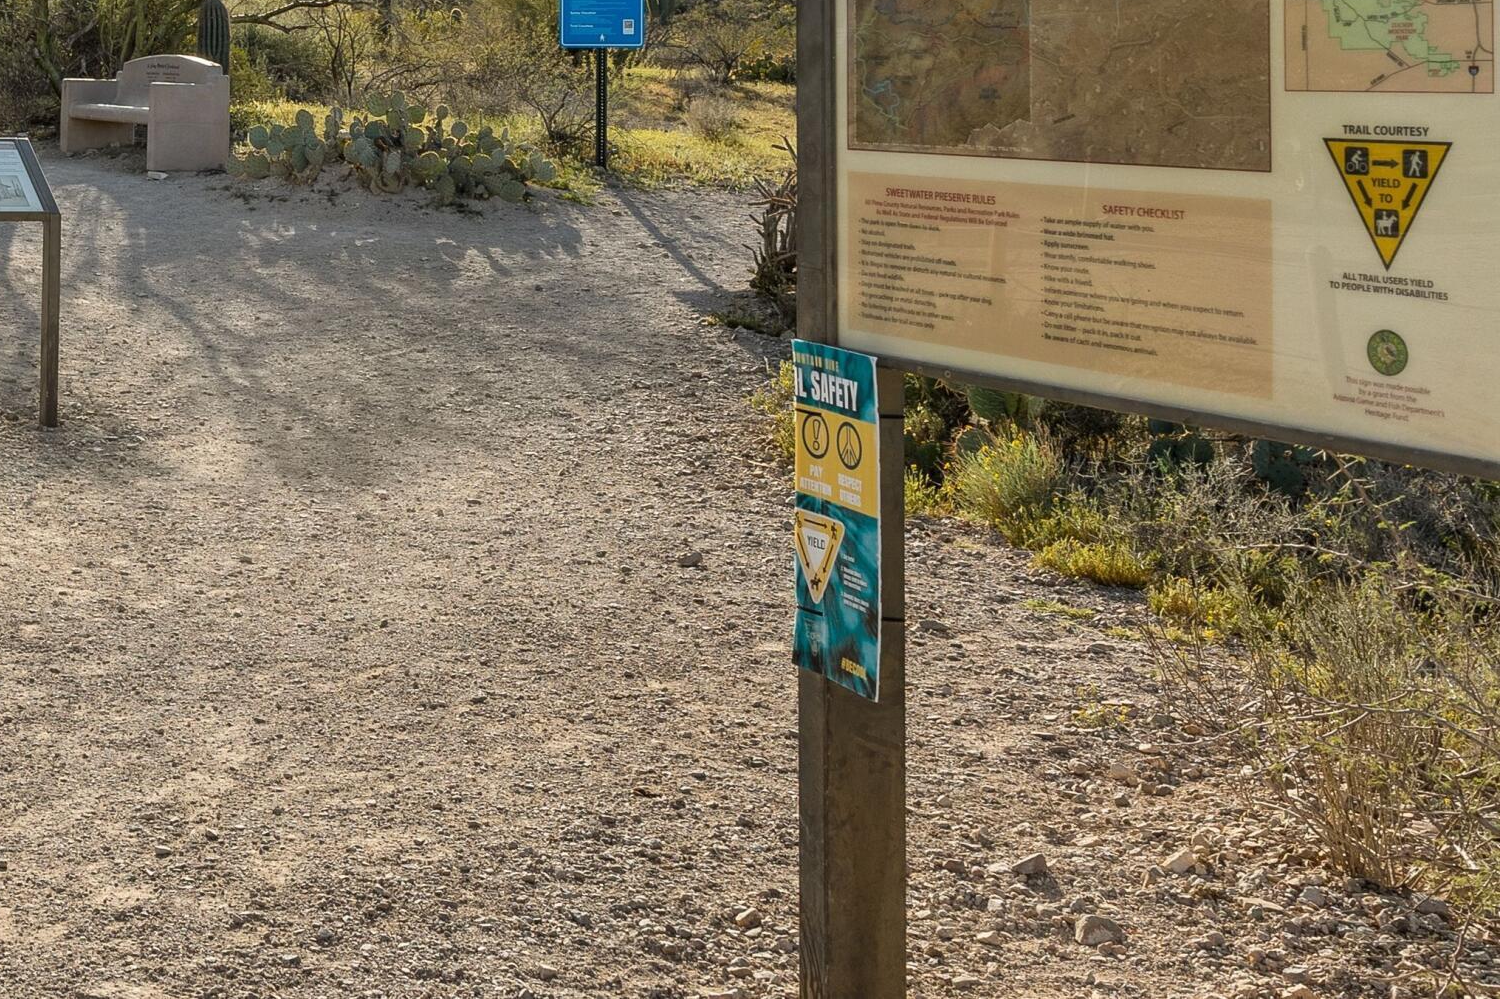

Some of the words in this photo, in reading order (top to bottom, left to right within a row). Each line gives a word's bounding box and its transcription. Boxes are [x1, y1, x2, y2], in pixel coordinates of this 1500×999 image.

[1342, 124, 1372, 136] TRAIL
[1373, 125, 1429, 137] COURTESY
[1371, 177, 1401, 189] YIELD
[885, 187, 932, 199] SWEETWATER
[934, 191, 970, 202] PRESERVE
[972, 194, 995, 205] RULES
[1379, 193, 1393, 204] TO
[1102, 204, 1136, 216] SAFETY
[1137, 208, 1185, 220] CHECKLIST
[1342, 272, 1357, 282] ALL
[1358, 273, 1381, 284] TRAIL
[1382, 275, 1409, 287] USERS
[1410, 278, 1434, 289] YIELD
[1329, 280, 1340, 289] TO
[1341, 281, 1372, 293] PEOPLE
[1373, 284, 1394, 295] WITH
[1395, 287, 1449, 301] DISABILITIES
[811, 370, 858, 412] SAFETY
[807, 535, 825, 550] YIELD
